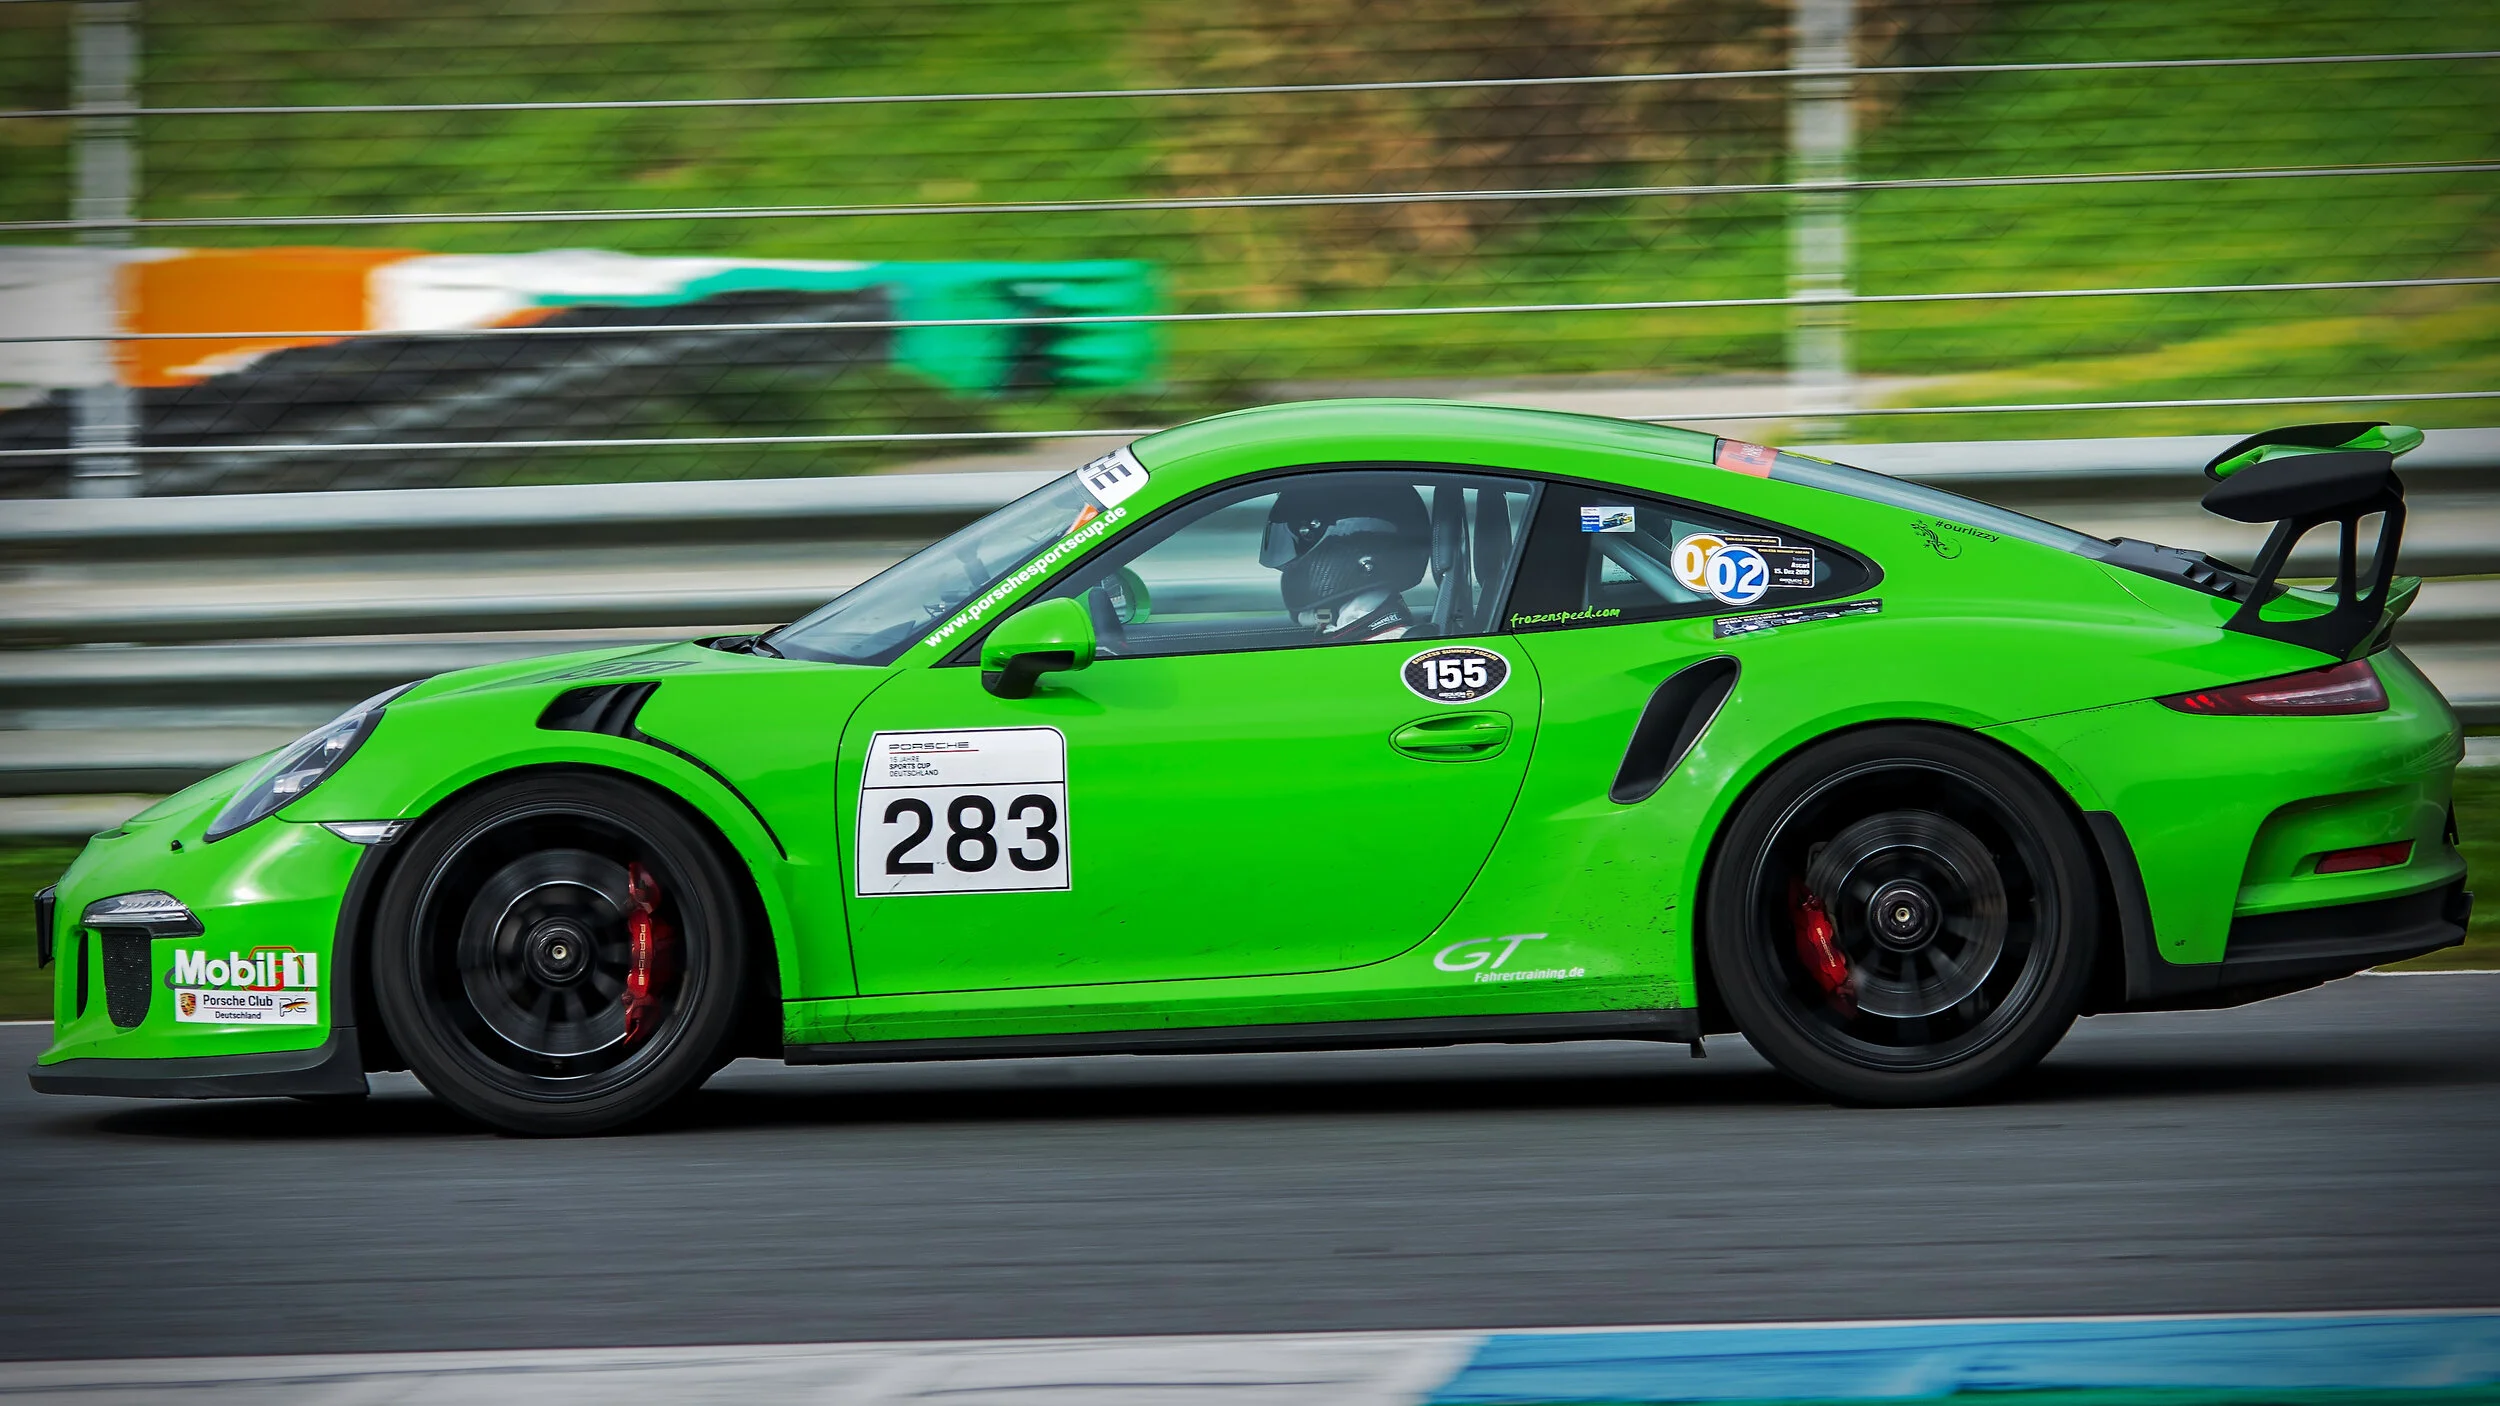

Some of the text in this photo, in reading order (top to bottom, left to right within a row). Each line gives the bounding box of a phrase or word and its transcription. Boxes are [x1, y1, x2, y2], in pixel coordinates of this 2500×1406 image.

[1935, 520, 2000, 543] #ourlizzy
[925, 506, 1127, 647] www.porschesportscup.de
[1707, 556, 1764, 593] 02
[1510, 605, 1620, 628] frozenspeed.com
[1422, 658, 1488, 689] 155
[889, 741, 969, 750] PORSCHE
[889, 769, 939, 777] DEUTSCHLAND
[883, 794, 1060, 875] 283
[638, 923, 646, 986] PORSCHE
[1433, 933, 1548, 972] GT
[175, 949, 318, 987] Mobil 1
[1474, 967, 1585, 982] Fahrertraining.de
[203, 994, 273, 1006] Porsche Club
[215, 1011, 262, 1020] Deutschland
